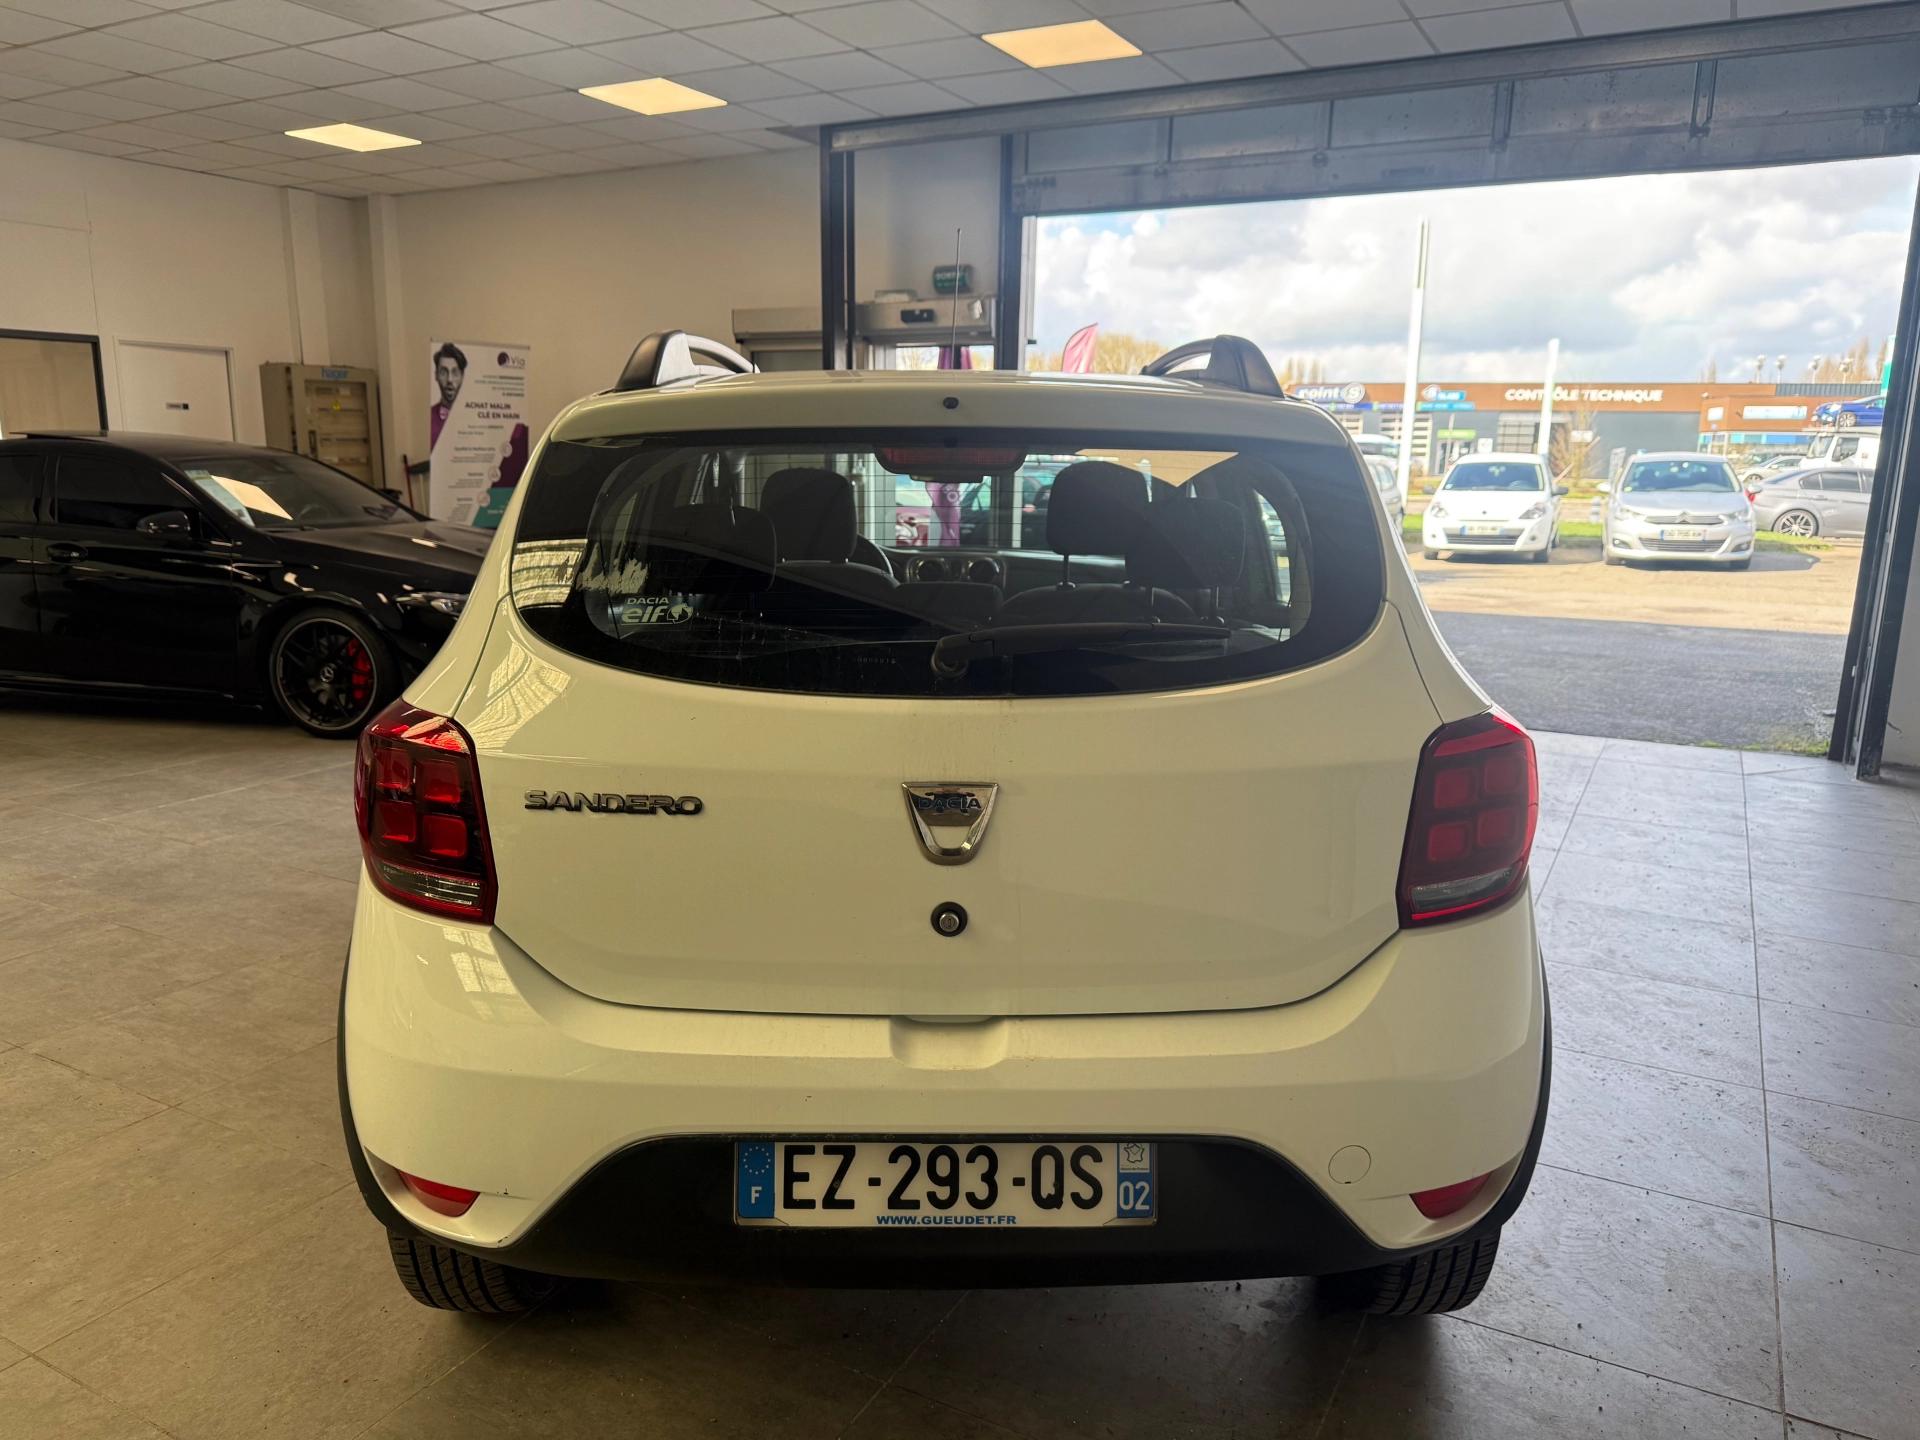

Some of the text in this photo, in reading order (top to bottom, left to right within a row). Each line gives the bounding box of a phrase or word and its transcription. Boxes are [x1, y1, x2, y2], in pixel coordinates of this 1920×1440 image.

[1505, 386, 1664, 404] CONTÔLE TECHNIQUE
[465, 402, 511, 410] ACHAT MALIN
[477, 411, 490, 419] CLÉ
[503, 412, 520, 420] MAIN
[627, 597, 670, 605] DACIA
[622, 605, 668, 623] elf
[524, 789, 704, 815] SANDERO
[783, 1144, 1104, 1210] EZ-293-QS
[751, 1186, 763, 1204] F
[1119, 1181, 1150, 1211] 02
[876, 1215, 1017, 1225] WWW.GUEUDET.FR
